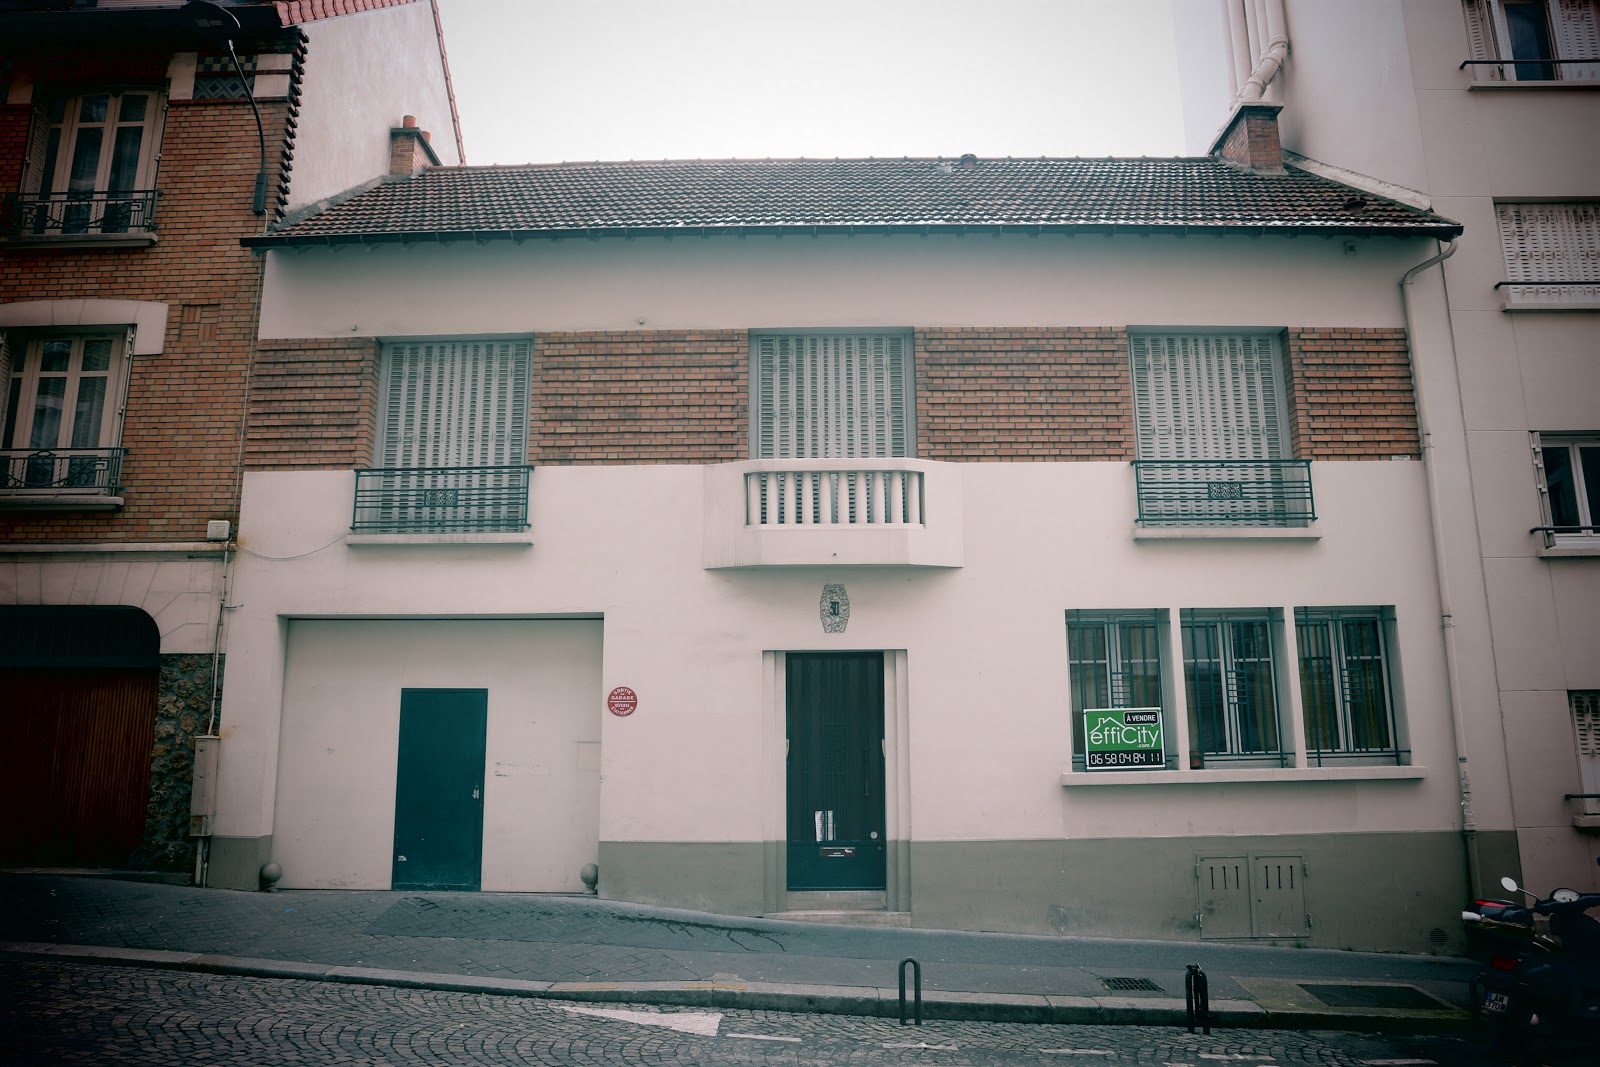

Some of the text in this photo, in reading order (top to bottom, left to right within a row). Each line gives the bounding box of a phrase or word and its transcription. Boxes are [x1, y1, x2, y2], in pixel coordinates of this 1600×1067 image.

[613, 688, 633, 696] SORTIE
[1126, 713, 1156, 722] À VENDRE
[1090, 726, 1159, 748] effiCity
[1090, 752, 1160, 765] 06 58 04 84 11
